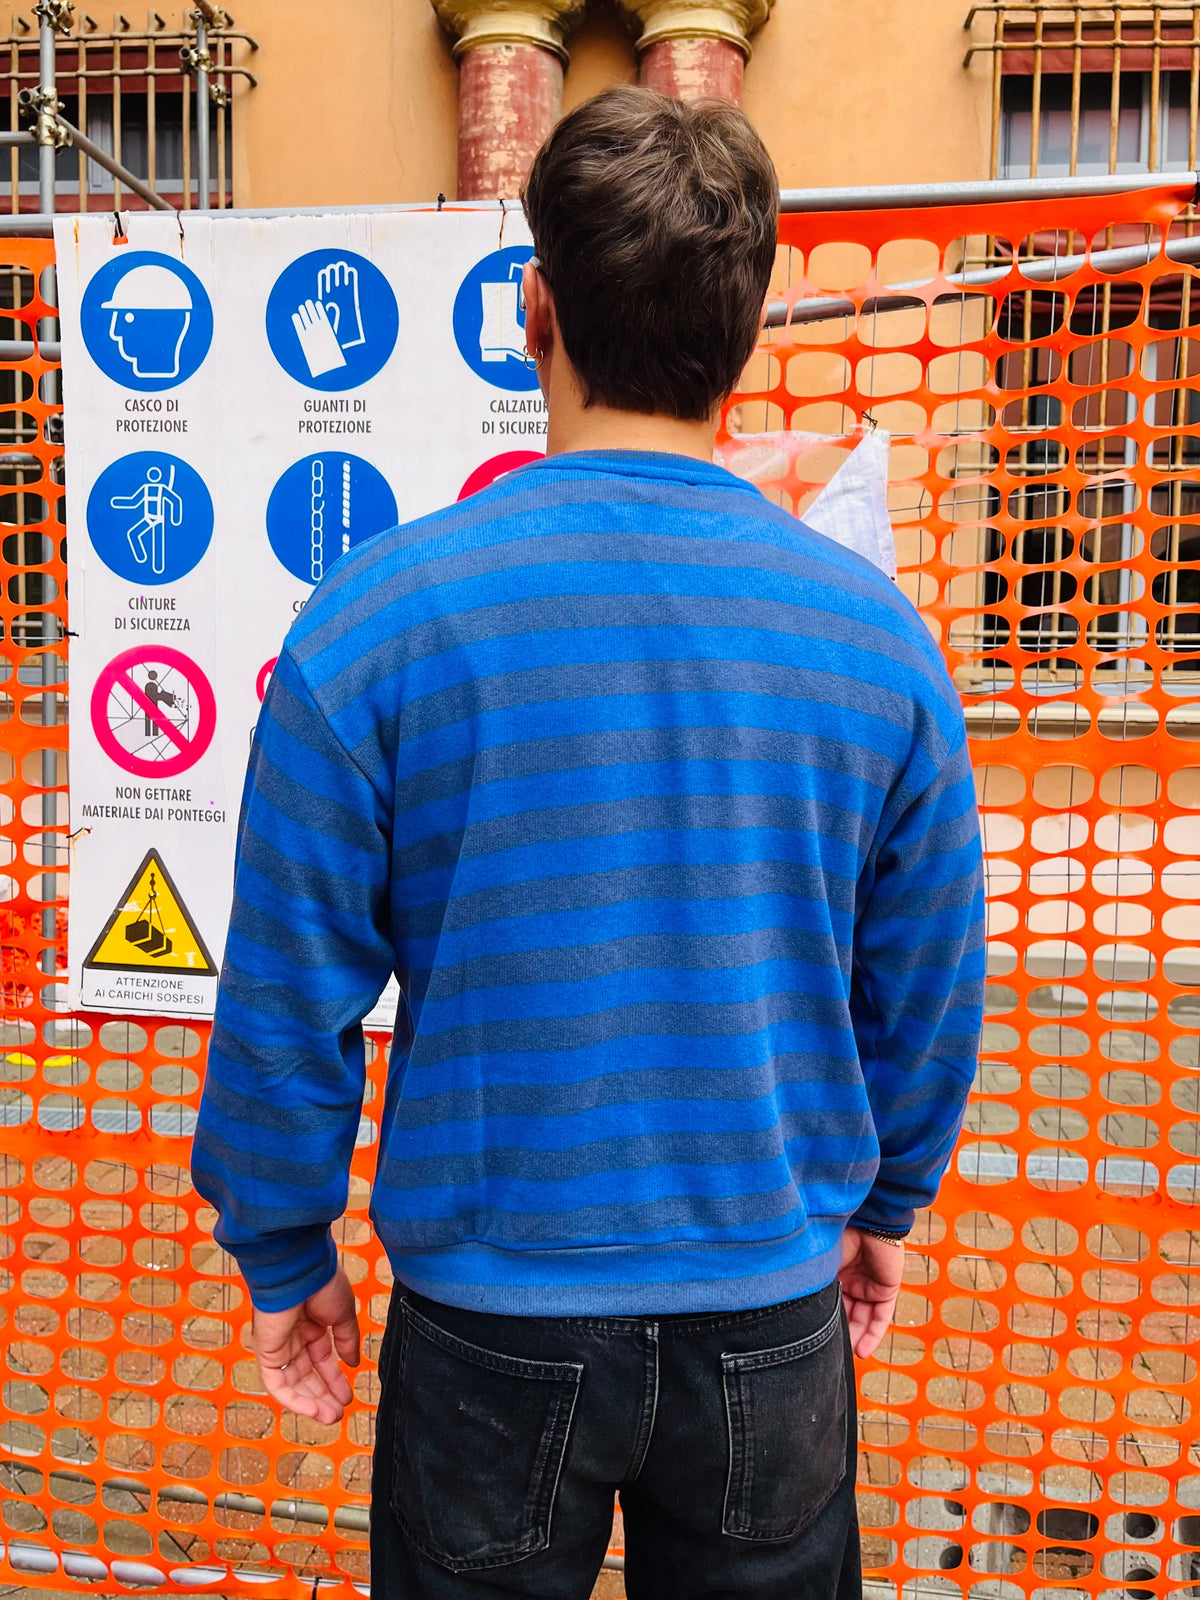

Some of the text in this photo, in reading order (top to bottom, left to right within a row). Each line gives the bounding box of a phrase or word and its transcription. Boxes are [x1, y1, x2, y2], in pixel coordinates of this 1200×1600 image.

[124, 399, 179, 412] CASCO DI
[303, 399, 366, 413] GUANTI DI
[116, 419, 188, 433] PROTEZIONE
[298, 420, 372, 434] PROTEZIONE
[481, 421, 495, 434] DI
[128, 598, 176, 611] CINTURE
[114, 617, 191, 632] DI SICUREZZA
[115, 786, 192, 802] NON GETTARE
[82, 804, 226, 824] MATERIALE DAI PONTEGGI
[115, 976, 184, 990] ATTENZIONE
[94, 988, 205, 1004] AI CARICHI SOSPESI
